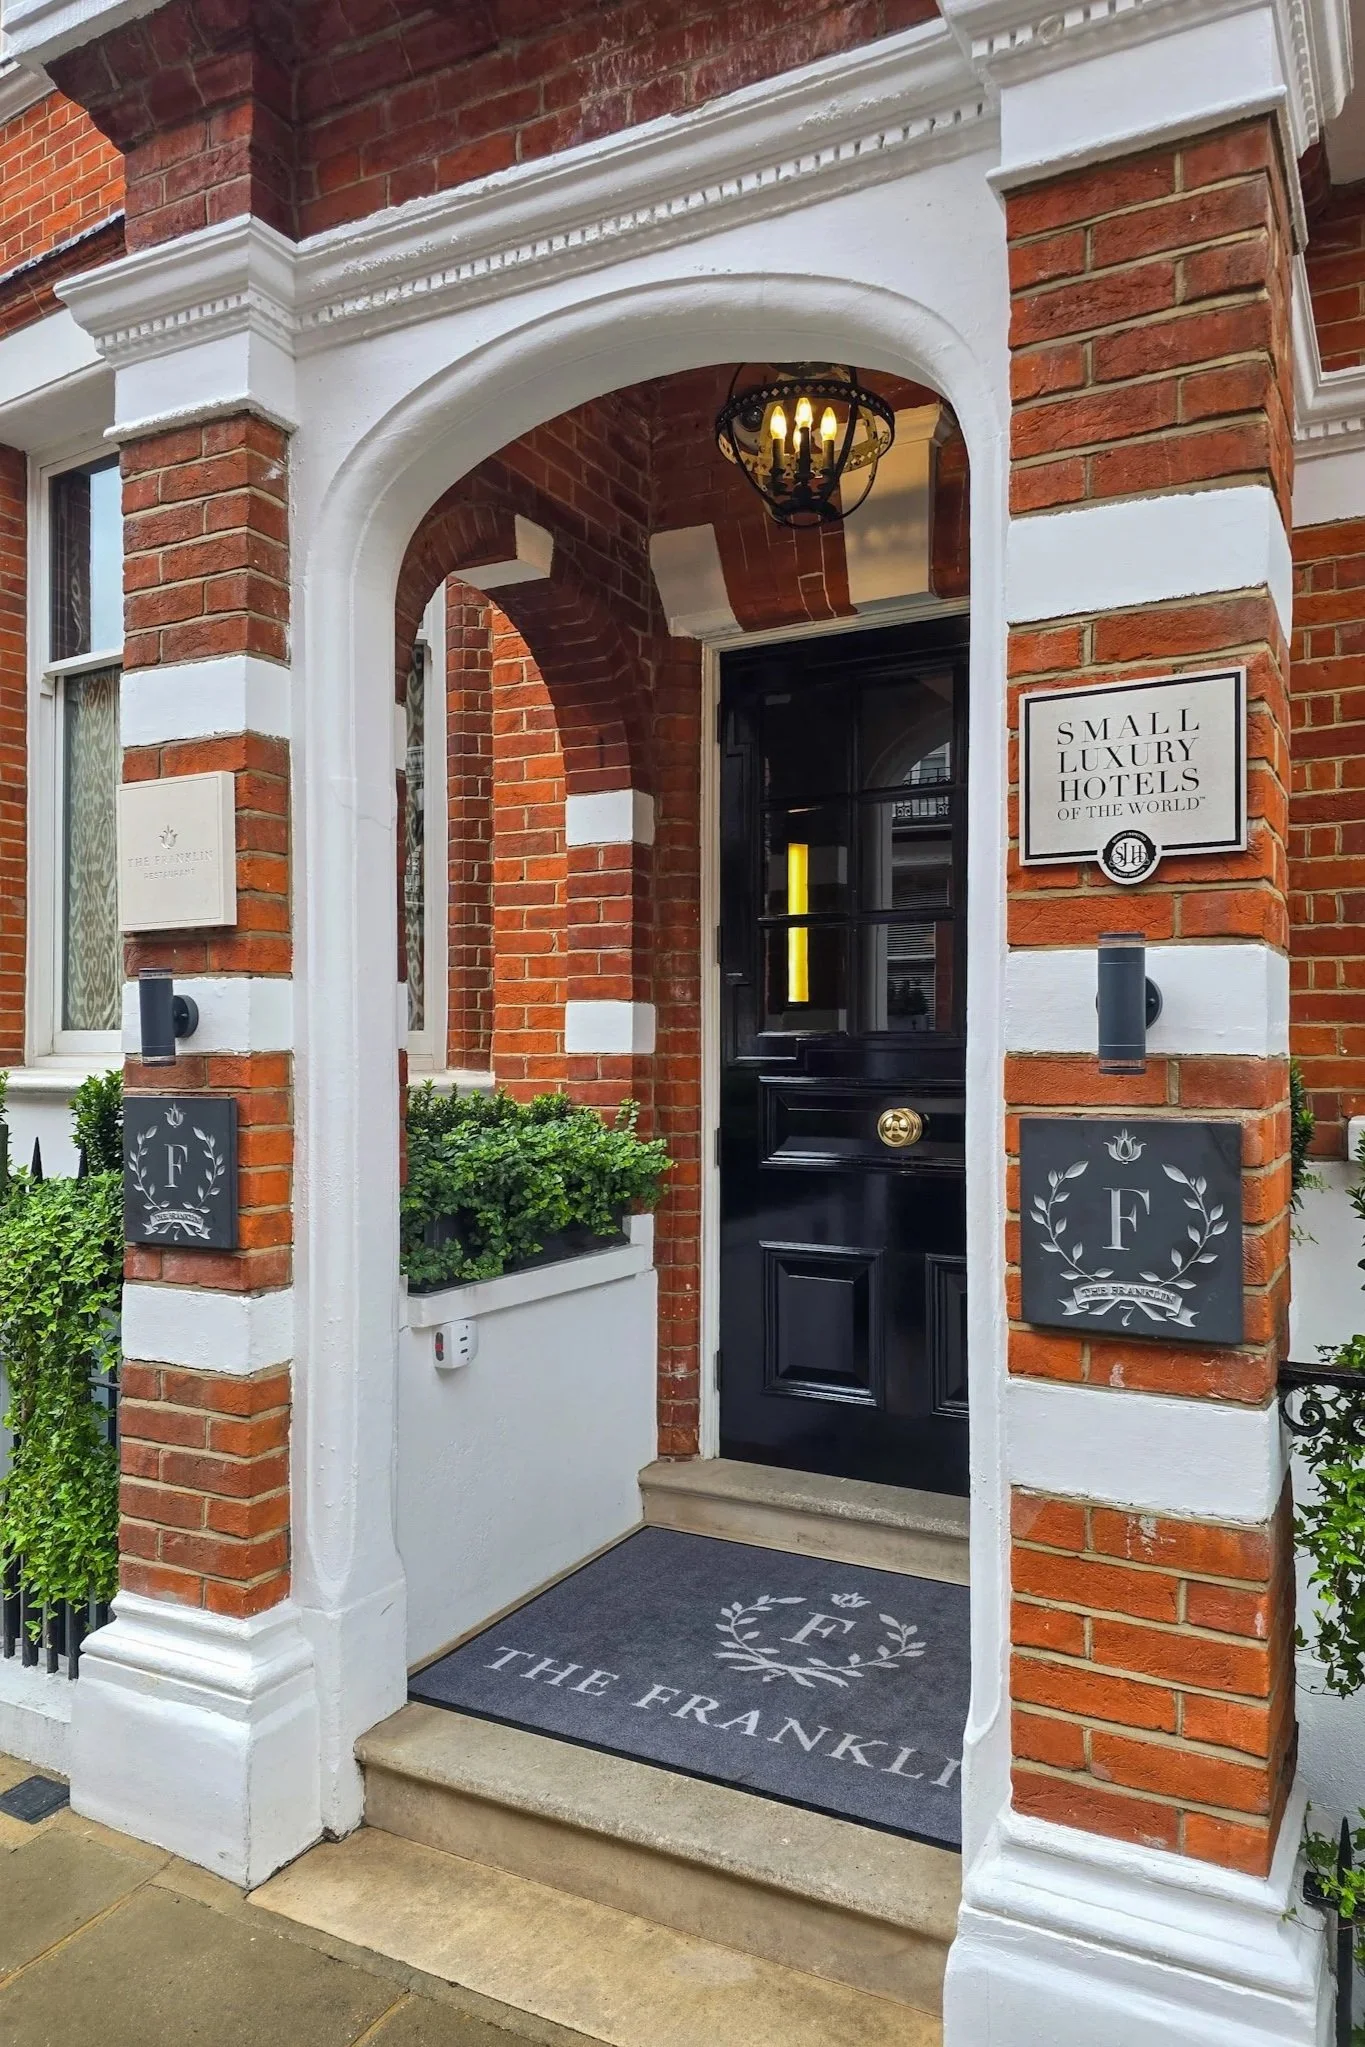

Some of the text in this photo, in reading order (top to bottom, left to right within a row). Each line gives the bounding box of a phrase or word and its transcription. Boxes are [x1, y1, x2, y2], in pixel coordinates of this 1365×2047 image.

[1057, 707, 1200, 746] SMALL
[1057, 737, 1200, 775] LUXURY
[1057, 767, 1201, 804] HOTELS
[1057, 806, 1081, 822] OF
[1086, 803, 1123, 819] THE
[164, 1143, 188, 1189] F
[1102, 1186, 1151, 1251] F
[779, 1611, 857, 1646] F
[483, 1646, 962, 1788] THE FRANKLI
